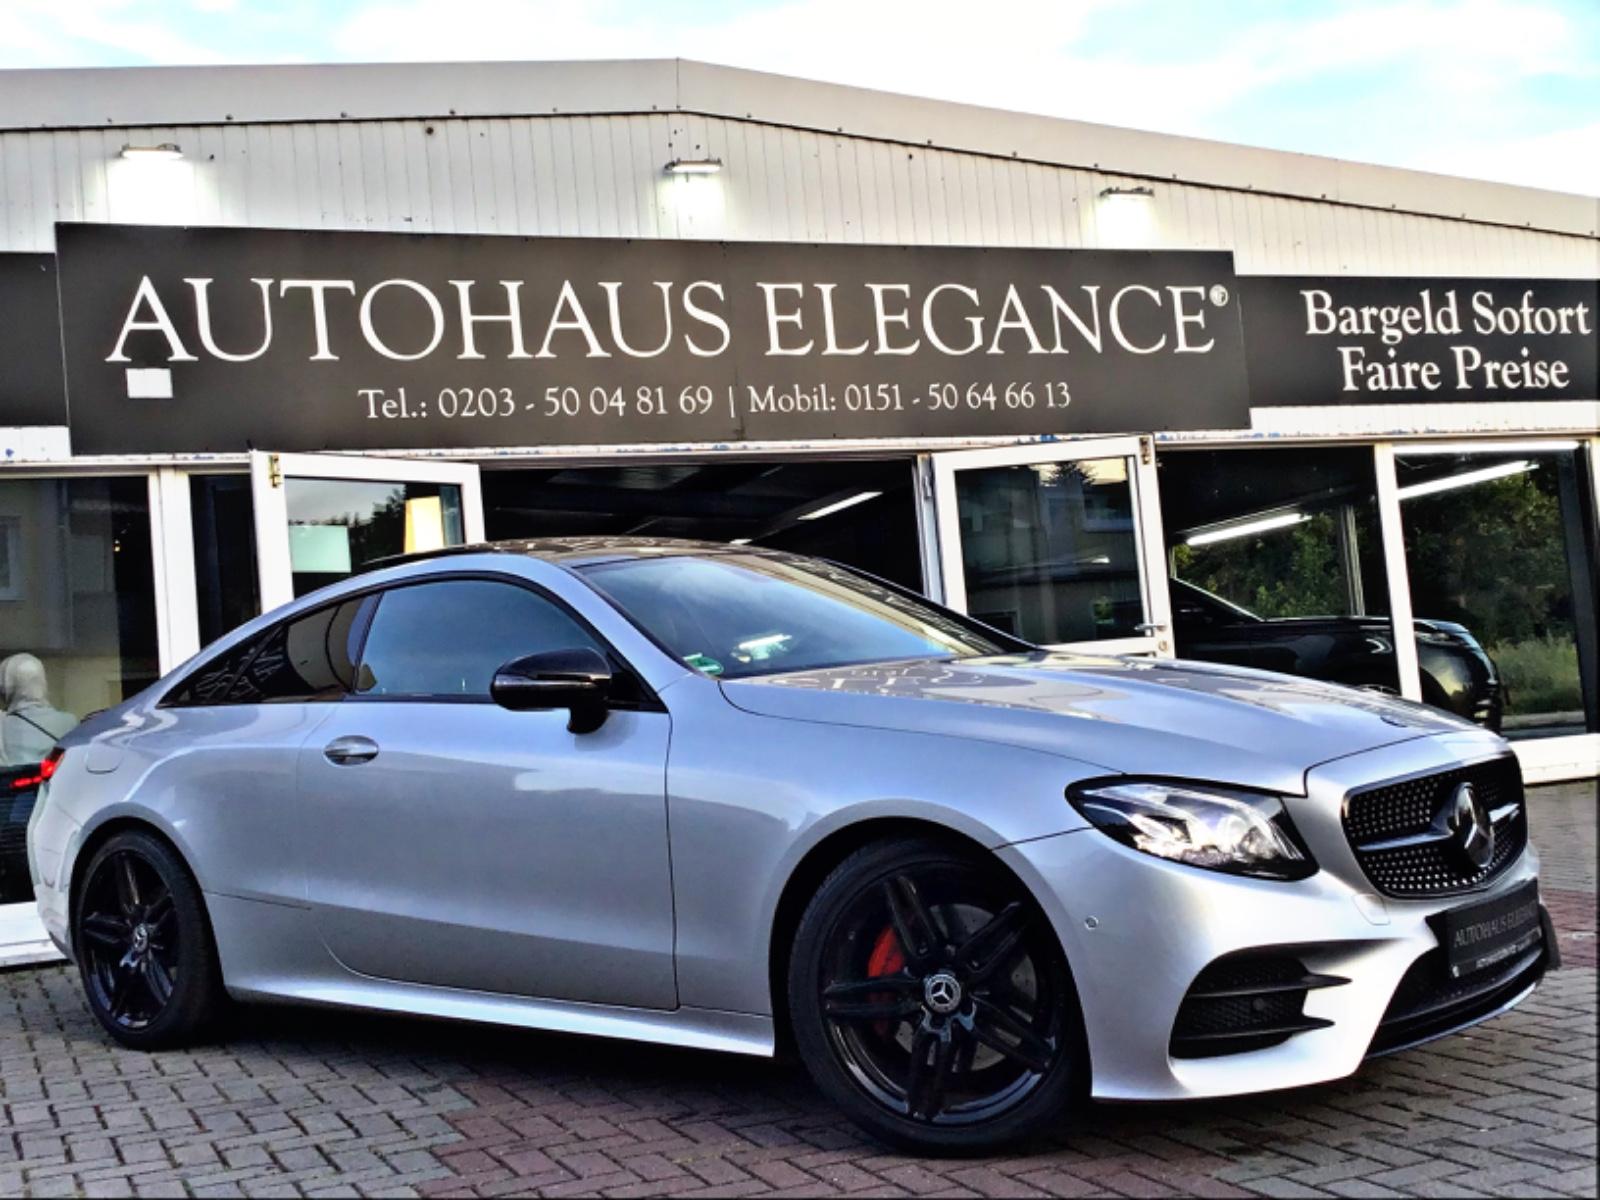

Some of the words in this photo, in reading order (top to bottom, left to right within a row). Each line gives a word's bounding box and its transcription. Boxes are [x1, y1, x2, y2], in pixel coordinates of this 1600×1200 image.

[104, 275, 731, 362] AUTOHAUS
[1299, 289, 1463, 346] Bargeld
[1471, 289, 1594, 336] Sofort
[1336, 346, 1442, 391] Faire
[1449, 345, 1570, 390] Preise
[357, 386, 428, 419] Tel.:
[437, 387, 516, 418] 0203
[544, 385, 582, 417] 50
[589, 385, 627, 417] 04
[636, 385, 669, 415] 81
[678, 384, 714, 415] 69
[746, 382, 837, 413] Mobil:
[844, 382, 905, 412] 0151
[927, 382, 959, 411] 50
[965, 381, 998, 411] 64
[1004, 381, 1036, 409] 66
[1044, 381, 1072, 409] 13
